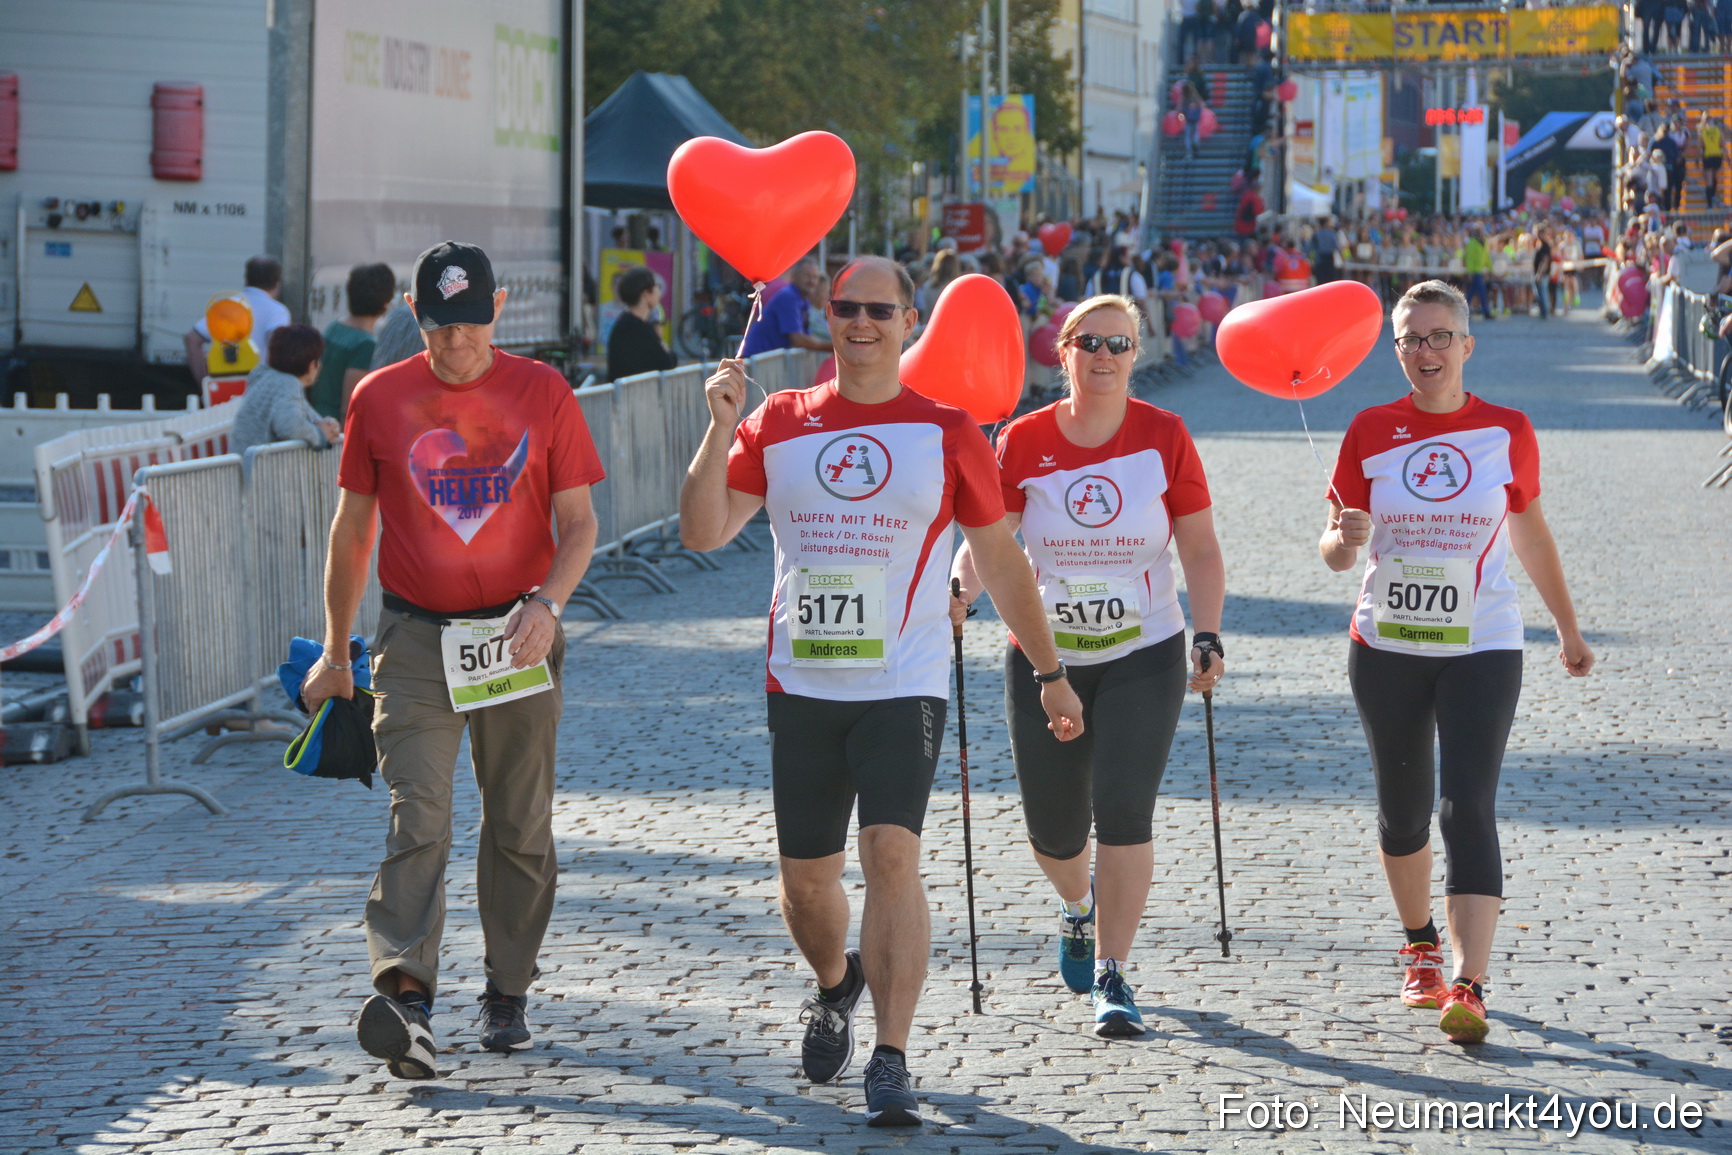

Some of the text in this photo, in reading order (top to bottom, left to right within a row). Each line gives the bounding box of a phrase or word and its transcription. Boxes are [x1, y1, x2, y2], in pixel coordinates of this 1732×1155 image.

[1393, 20, 1507, 47] START
[173, 201, 197, 214] NM
[457, 506, 483, 520] 2017
[790, 510, 909, 530] LAUFEN MIT HERZ
[1380, 512, 1493, 526] LAUFEN MIT HERZ
[800, 530, 894, 543] Dr. Heck / Dr. Röschl
[1405, 527, 1426, 536] Heck
[1427, 527, 1433, 535] /
[1434, 527, 1447, 536] Dr.
[1043, 536, 1146, 547] LAUFEN MIT HERZ
[800, 543, 890, 558] Leistungsdiagnostik
[1056, 559, 1133, 567] Leistungsdiagnostik
[1402, 565, 1445, 577] BOCK
[809, 574, 854, 586] BOCK
[1067, 583, 1108, 594] BOCK
[1387, 582, 1458, 613] 5070
[798, 594, 864, 625] 5171
[1055, 597, 1125, 624] 5170
[1399, 626, 1444, 641] Carmen
[809, 643, 858, 656] Andreas
[1077, 637, 1116, 649] Kerstin
[460, 634, 506, 672] 507
[468, 665, 515, 682] PARTL Neumark
[486, 679, 512, 696] Karl
